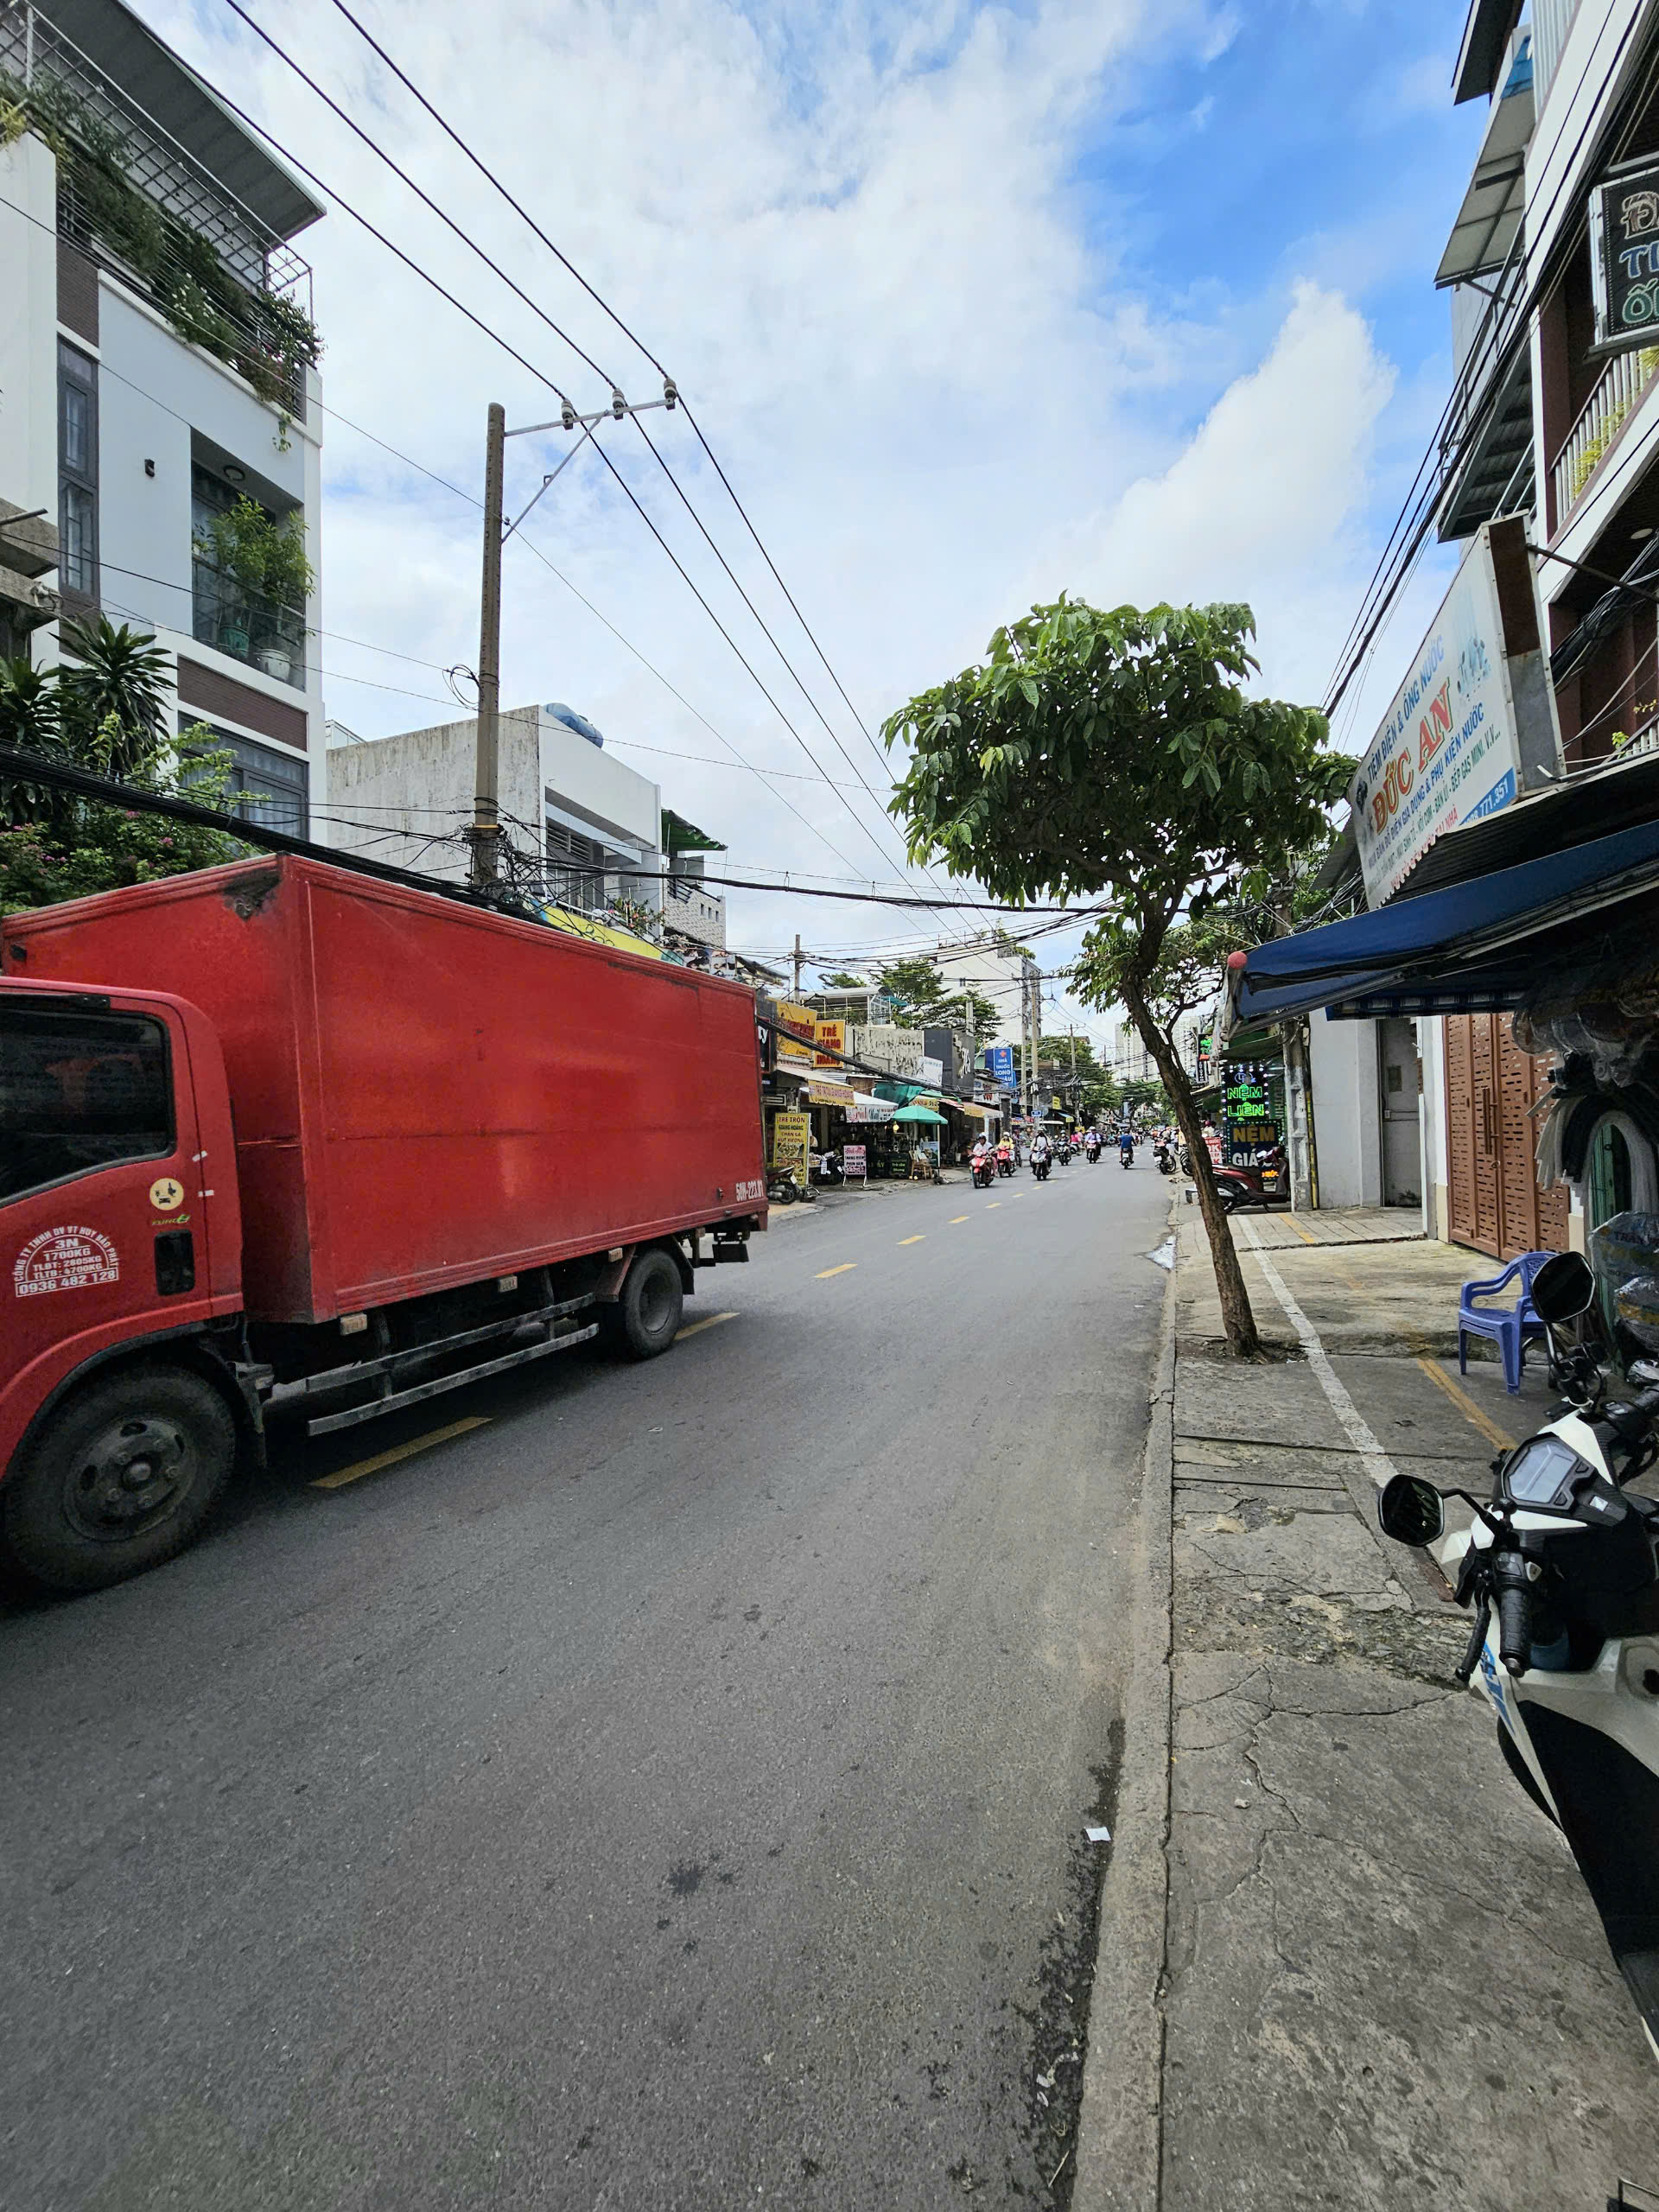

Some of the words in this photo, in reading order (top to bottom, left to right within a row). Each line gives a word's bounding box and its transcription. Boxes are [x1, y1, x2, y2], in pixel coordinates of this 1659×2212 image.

[1367, 753, 1382, 784] TIỆM
[1381, 721, 1397, 760] ĐIỆN
[1397, 710, 1404, 733] &
[1403, 680, 1420, 721] ỐNG
[1420, 634, 1445, 693] NƯỚC
[1372, 747, 1414, 836] ĐỨC
[1418, 676, 1454, 774] AN
[1410, 785, 1425, 815] DỤNG
[1425, 778, 1431, 795] &
[1430, 759, 1444, 785] PHỤ
[1444, 732, 1462, 768] KIỆN
[1462, 702, 1484, 744] NƯỚC
[1451, 764, 1460, 792] BẾP
[1460, 755, 1471, 779] GAS
[1226, 1084, 1262, 1101] NỆM
[1232, 1124, 1275, 1146] NỆM
[1231, 1148, 1259, 1167] GIÁ
[12, 1259, 27, 1281] CÔNG
[20, 1247, 32, 1258] TY
[28, 1230, 53, 1249] TNHH
[67, 1225, 78, 1234] VT
[79, 1226, 98, 1238] HUY
[55, 1238, 79, 1249] 3N
[43, 1248, 91, 1262] 1700KG
[60, 1274, 87, 1287] 482
[91, 1270, 116, 1282] 128
